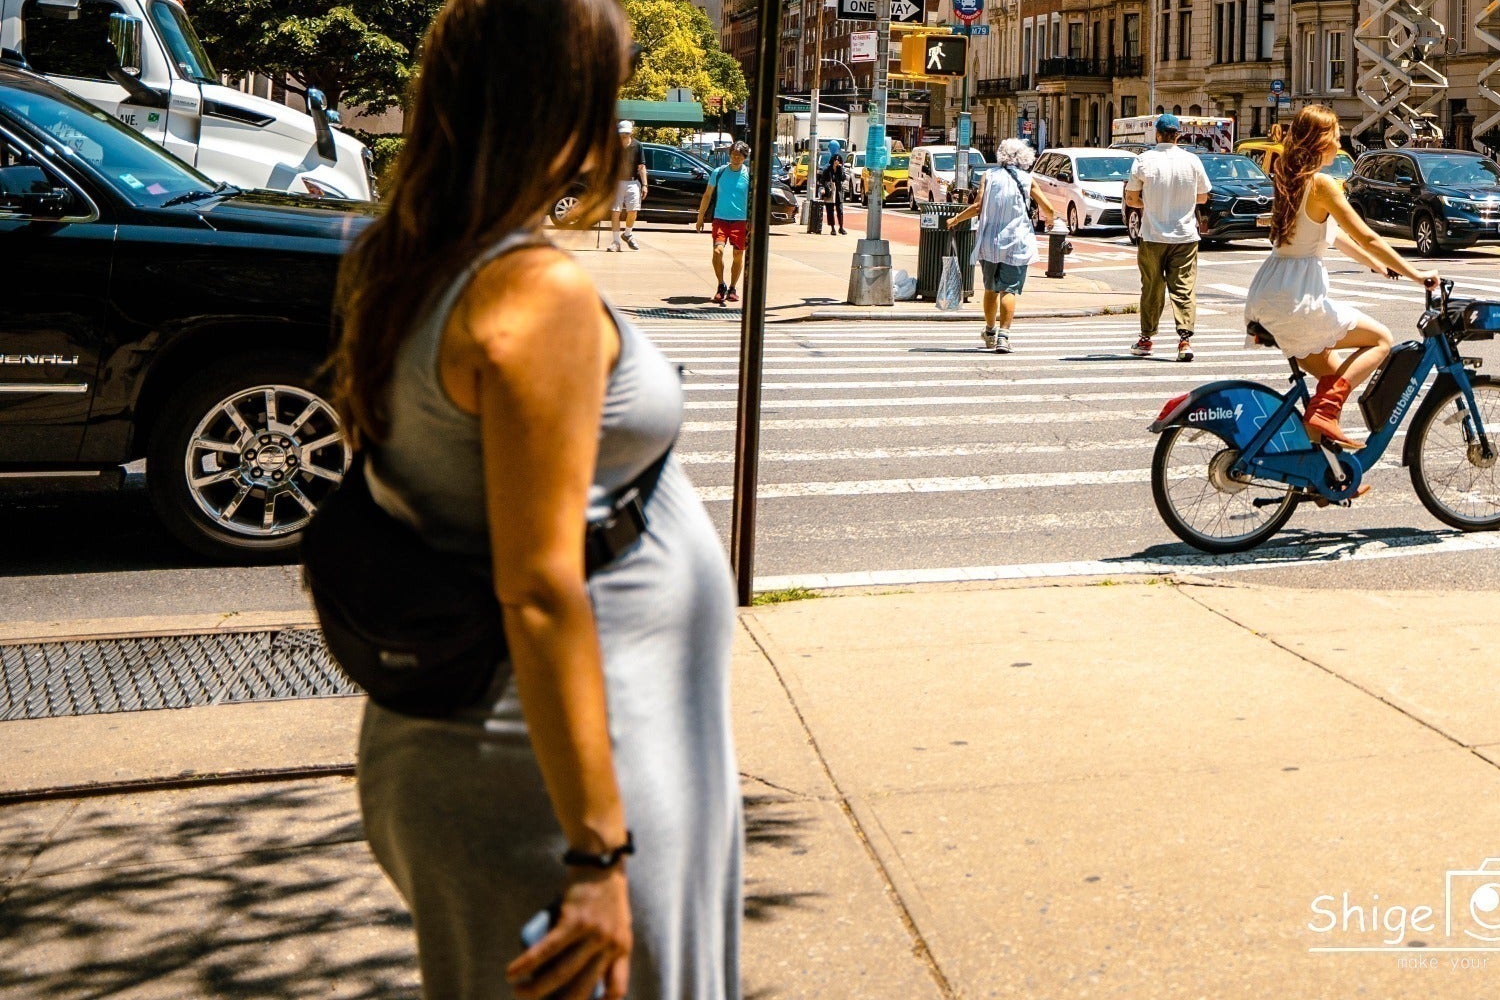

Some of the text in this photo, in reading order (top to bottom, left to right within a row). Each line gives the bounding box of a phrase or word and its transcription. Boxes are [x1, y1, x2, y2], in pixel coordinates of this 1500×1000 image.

[850, 0, 875, 12] ONE
[971, 27, 987, 35] M79
[120, 114, 138, 126] AVE.
[0, 354, 79, 364] ENALI
[1398, 384, 1415, 410] bike
[1188, 407, 1233, 422] citi bike
